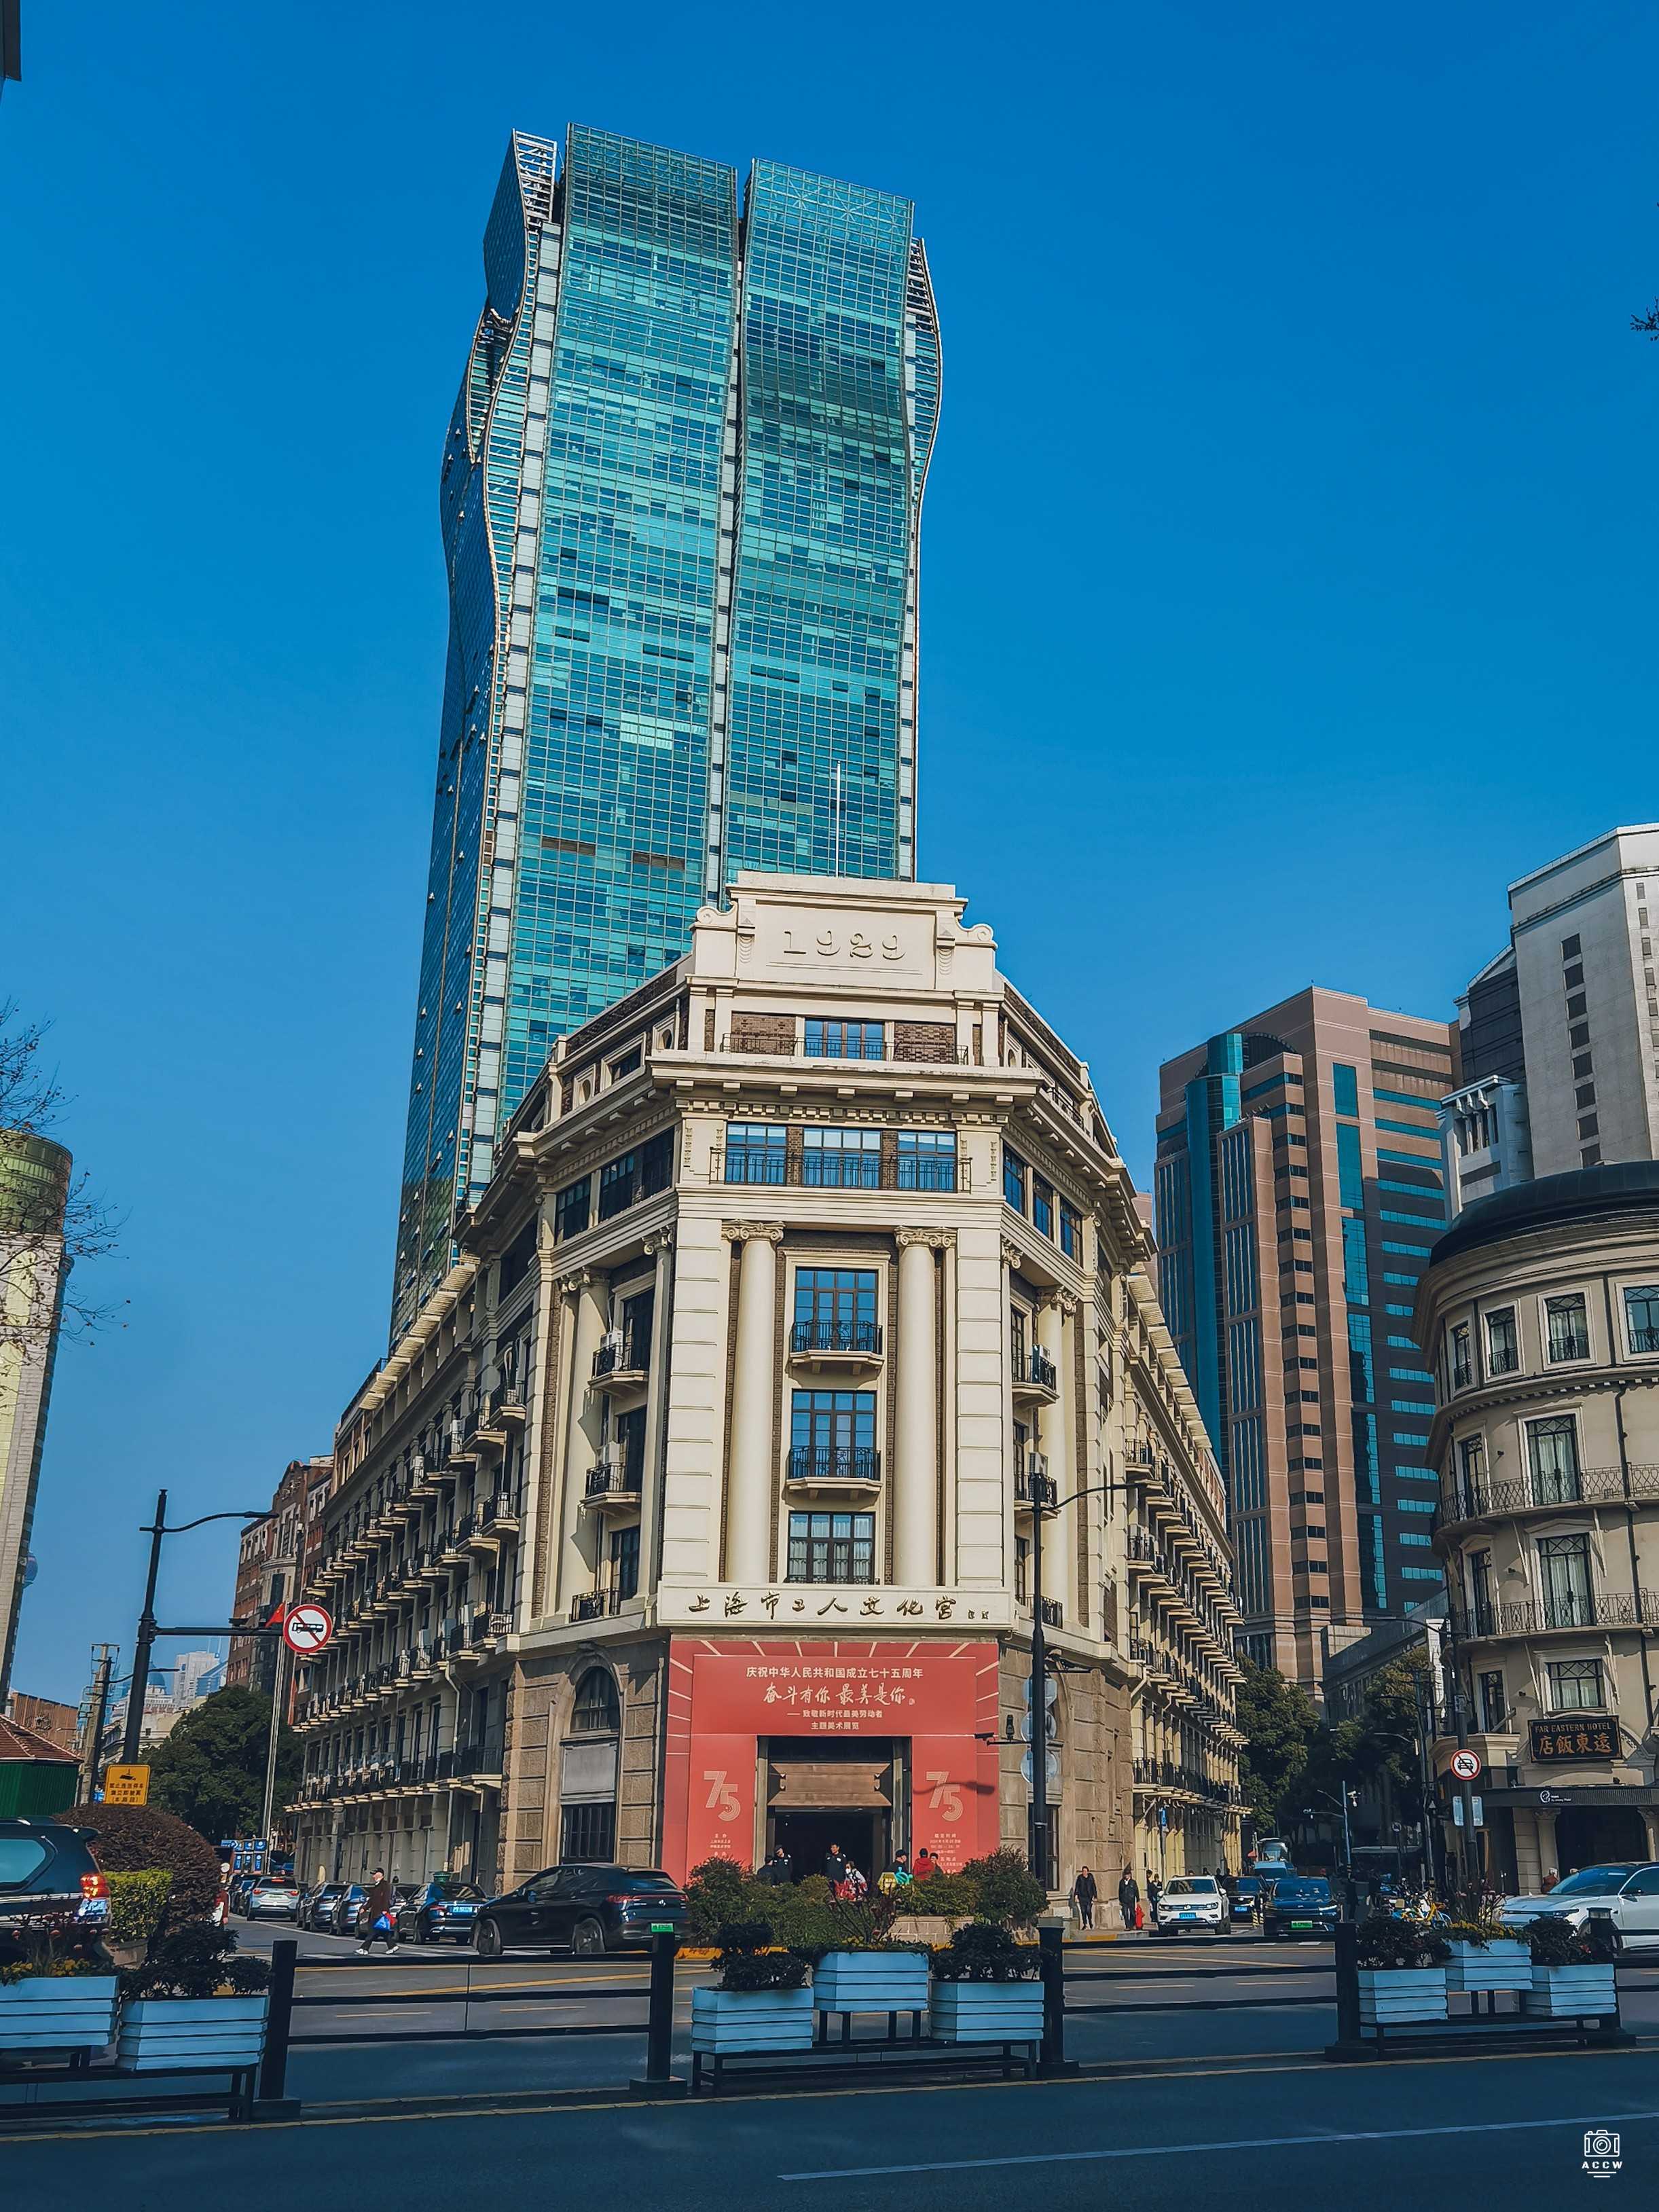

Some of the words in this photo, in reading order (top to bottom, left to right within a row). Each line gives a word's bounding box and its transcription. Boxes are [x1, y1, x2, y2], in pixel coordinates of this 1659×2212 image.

[783, 930, 907, 961] 1929
[688, 1591, 956, 1620] 上海市工人文化宫
[746, 1667, 924, 1679] 庆祝中华人民共和国成立七十五周年
[1535, 1725, 1550, 1733] FAR
[1552, 1724, 1584, 1733] EASTERN
[1587, 1722, 1611, 1730] HOTEL
[704, 1771, 741, 1821] 75
[926, 1771, 964, 1821] 75
